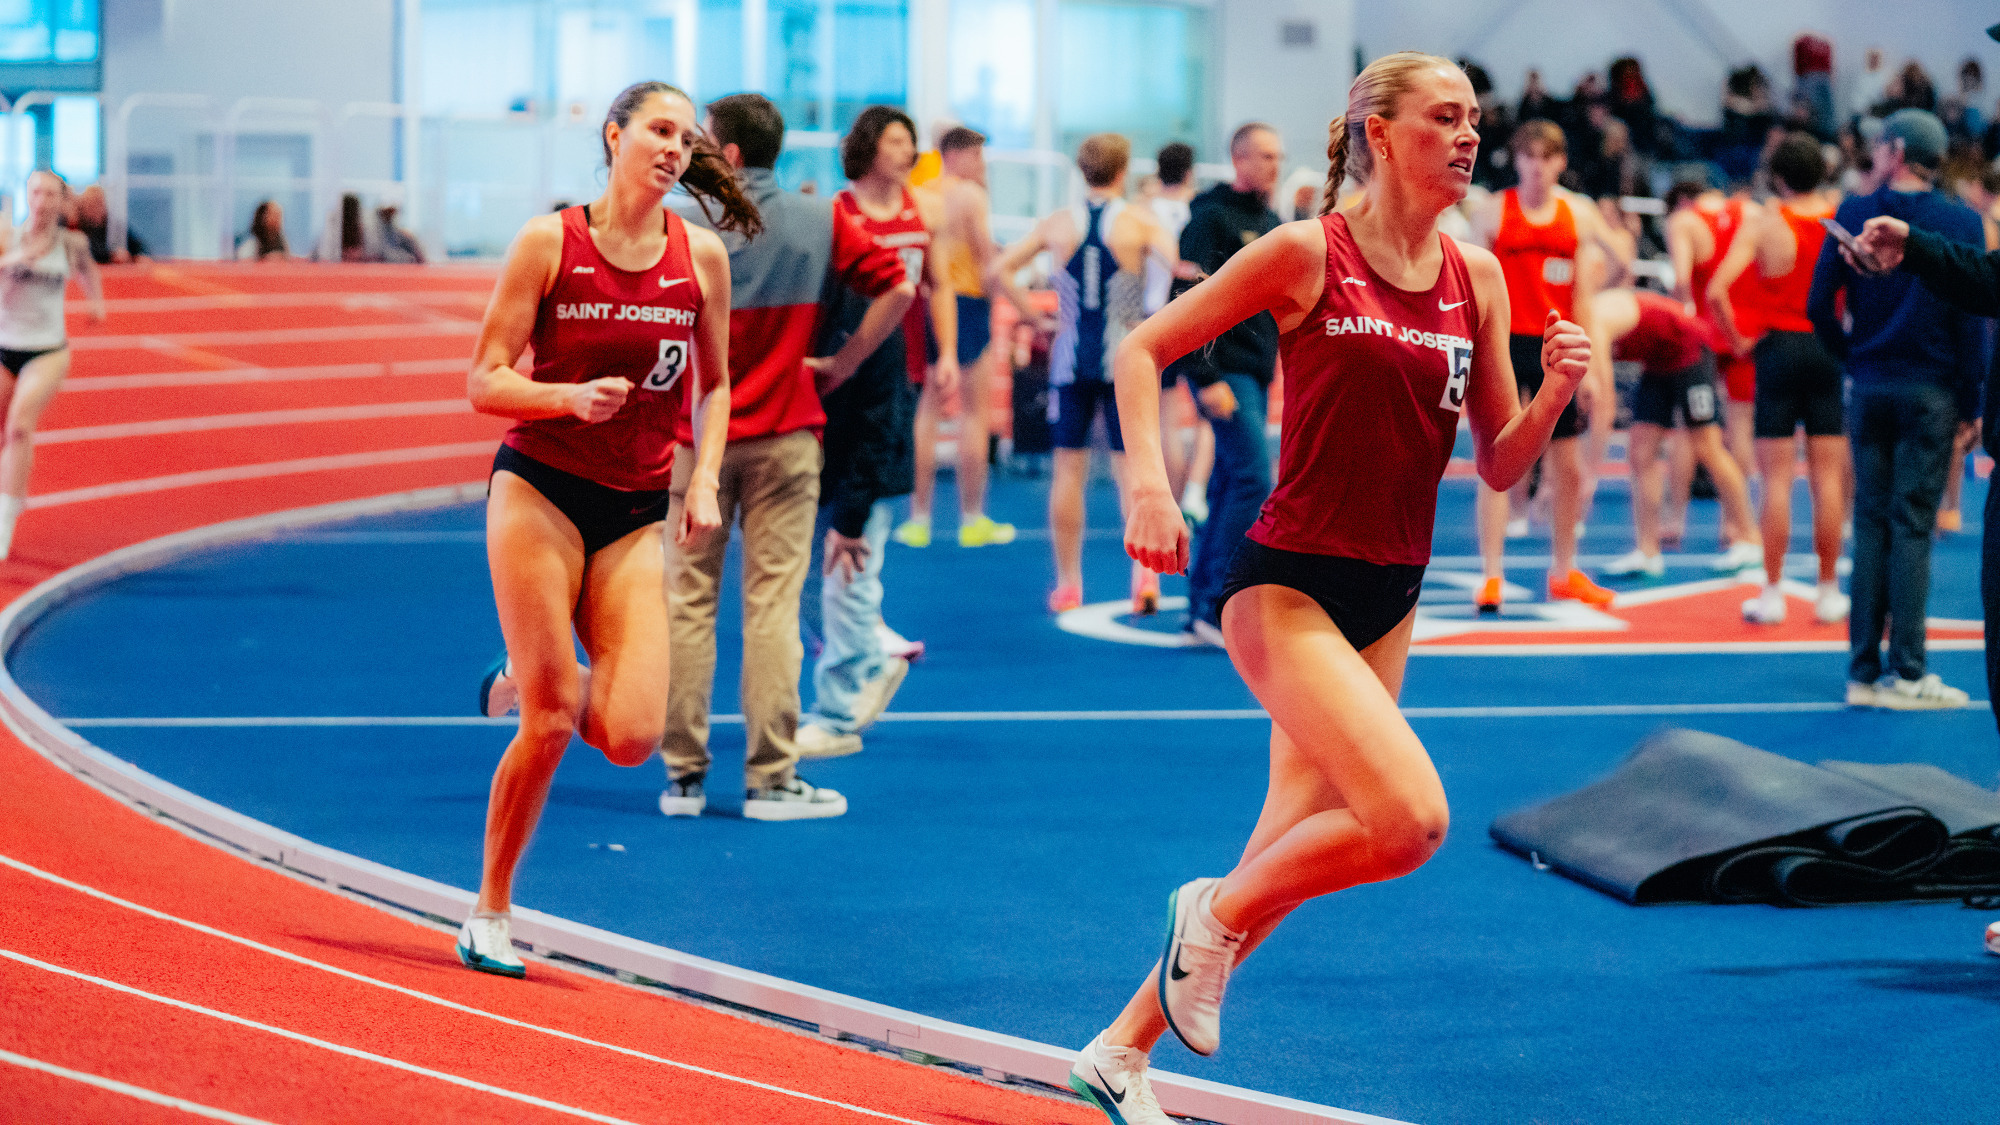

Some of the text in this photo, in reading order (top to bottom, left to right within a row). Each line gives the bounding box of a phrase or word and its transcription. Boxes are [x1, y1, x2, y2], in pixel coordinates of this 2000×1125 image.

[556, 303, 697, 327] SAINT JOSEPH'S
[1325, 316, 1393, 337] SAINT
[651, 345, 682, 387] 3
[1449, 346, 1472, 408] 5
